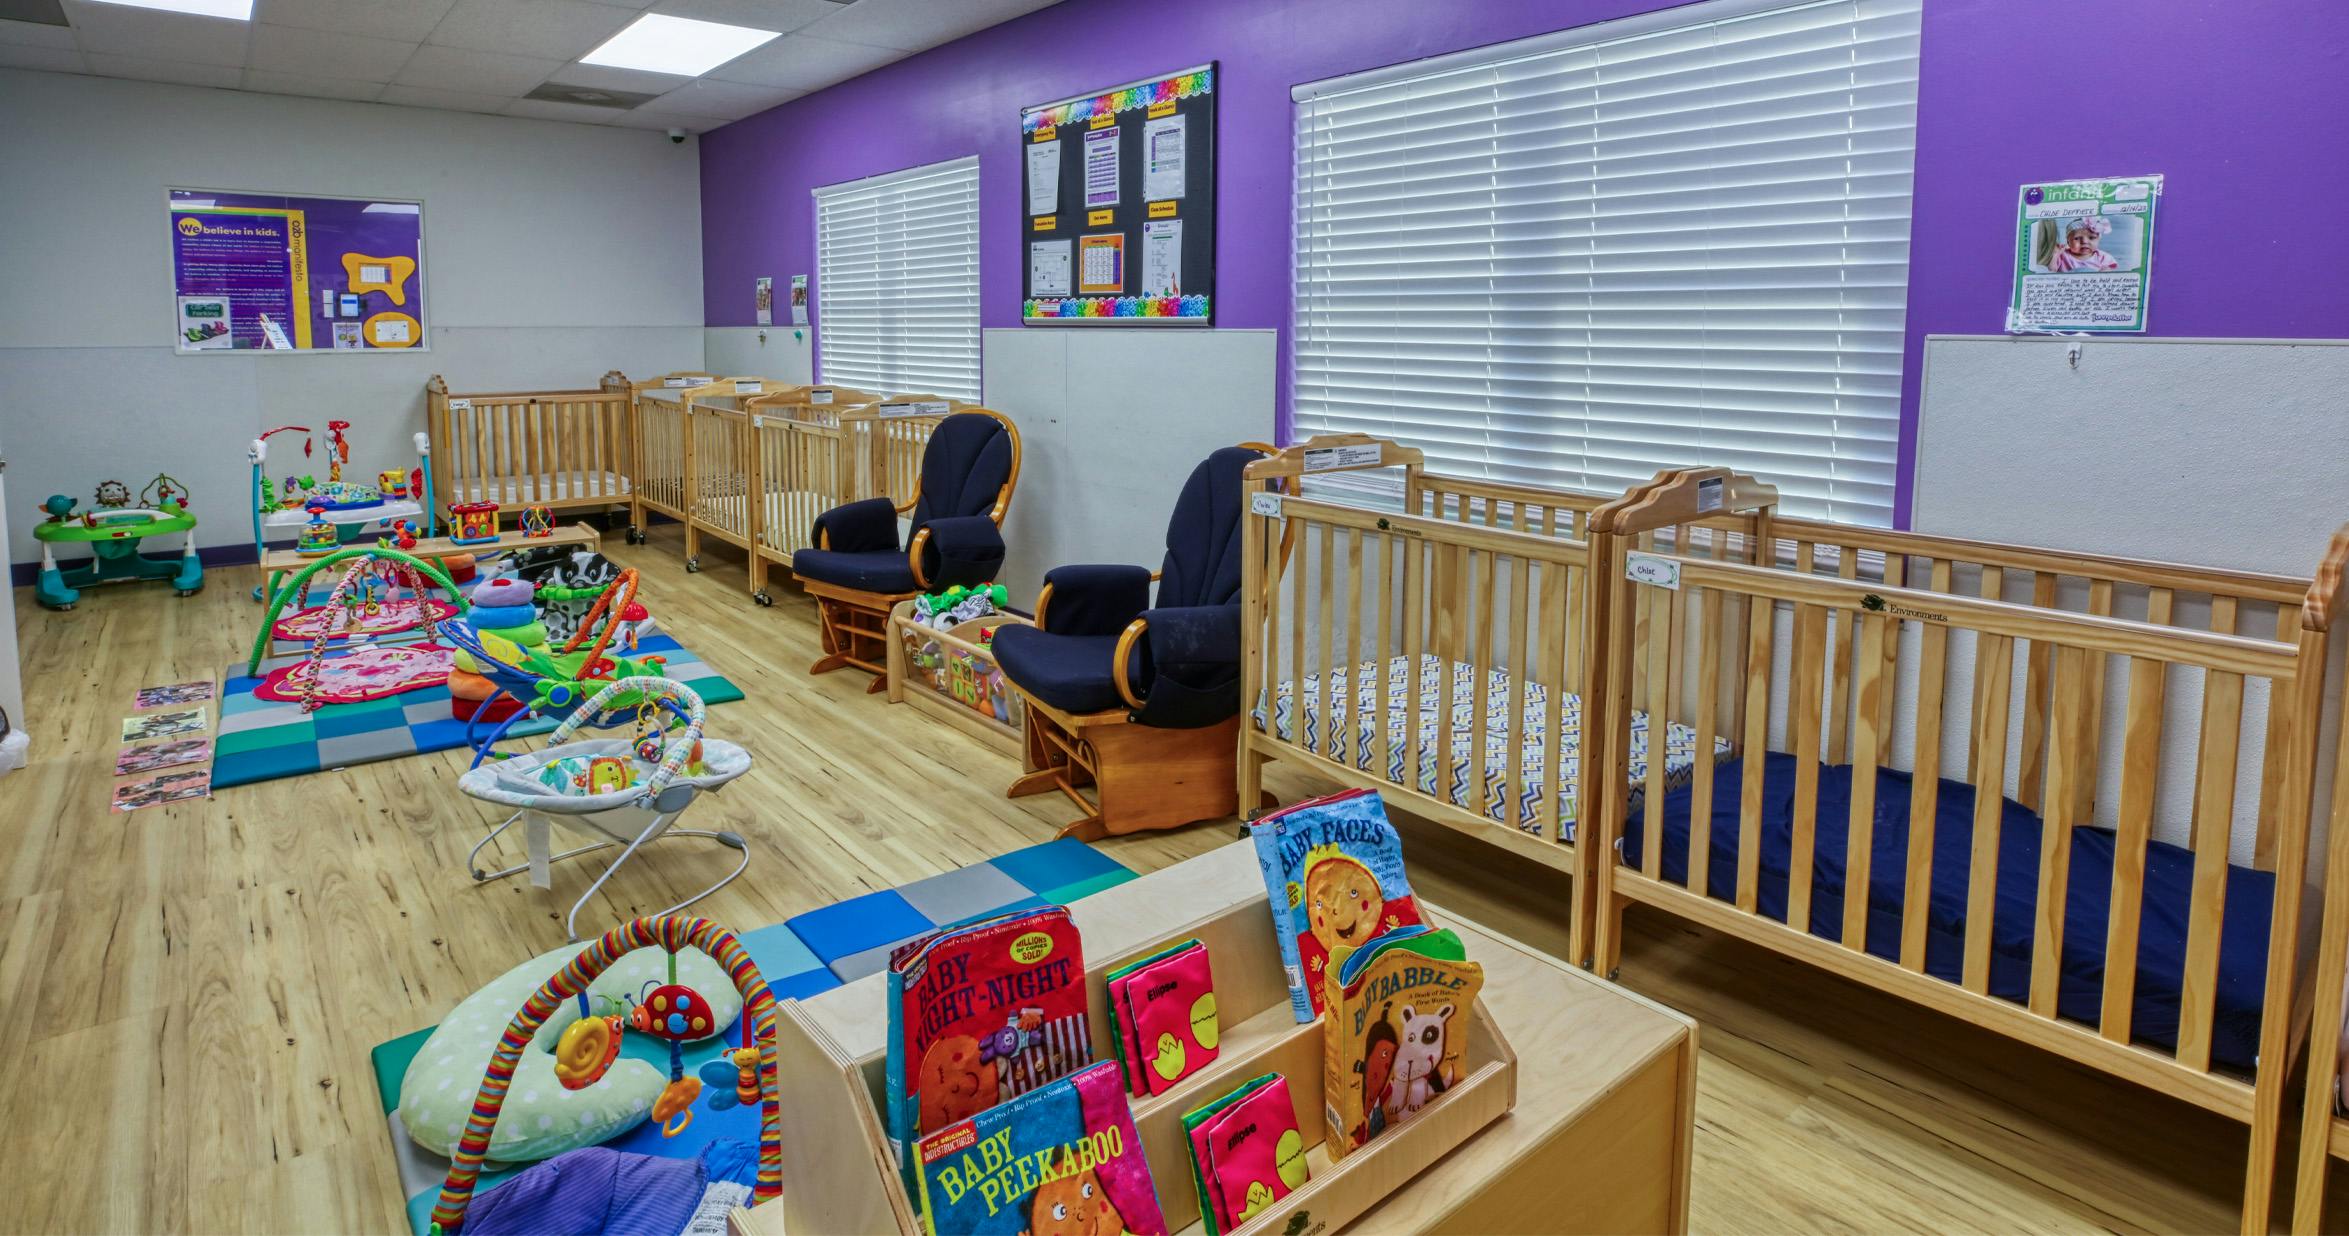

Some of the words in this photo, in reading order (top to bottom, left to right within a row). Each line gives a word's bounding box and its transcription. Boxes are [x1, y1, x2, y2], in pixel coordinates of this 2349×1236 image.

[180, 223, 200, 234] We
[202, 225, 242, 236] believe
[244, 226, 254, 236] in
[256, 226, 280, 237] kids.
[1890, 604, 1948, 622] Environments
[1280, 826, 1315, 877] BABY
[1320, 818, 1385, 846] FACES
[972, 930, 990, 941] Proof
[1016, 936, 1047, 948] MILLIONS
[1026, 942, 1048, 952] COPIES
[917, 952, 971, 1014] BABY
[1147, 980, 1178, 1002] Ellipse
[1378, 966, 1468, 1002] BABBLE
[1076, 1074, 1092, 1086] 100%
[924, 1132, 975, 1162] INDESTRUCTIBLES
[926, 1139, 940, 1150] THE
[940, 1128, 971, 1144] ORIGINAL
[938, 1126, 1015, 1205] BABY
[978, 1124, 1124, 1216] PEEKABOO
